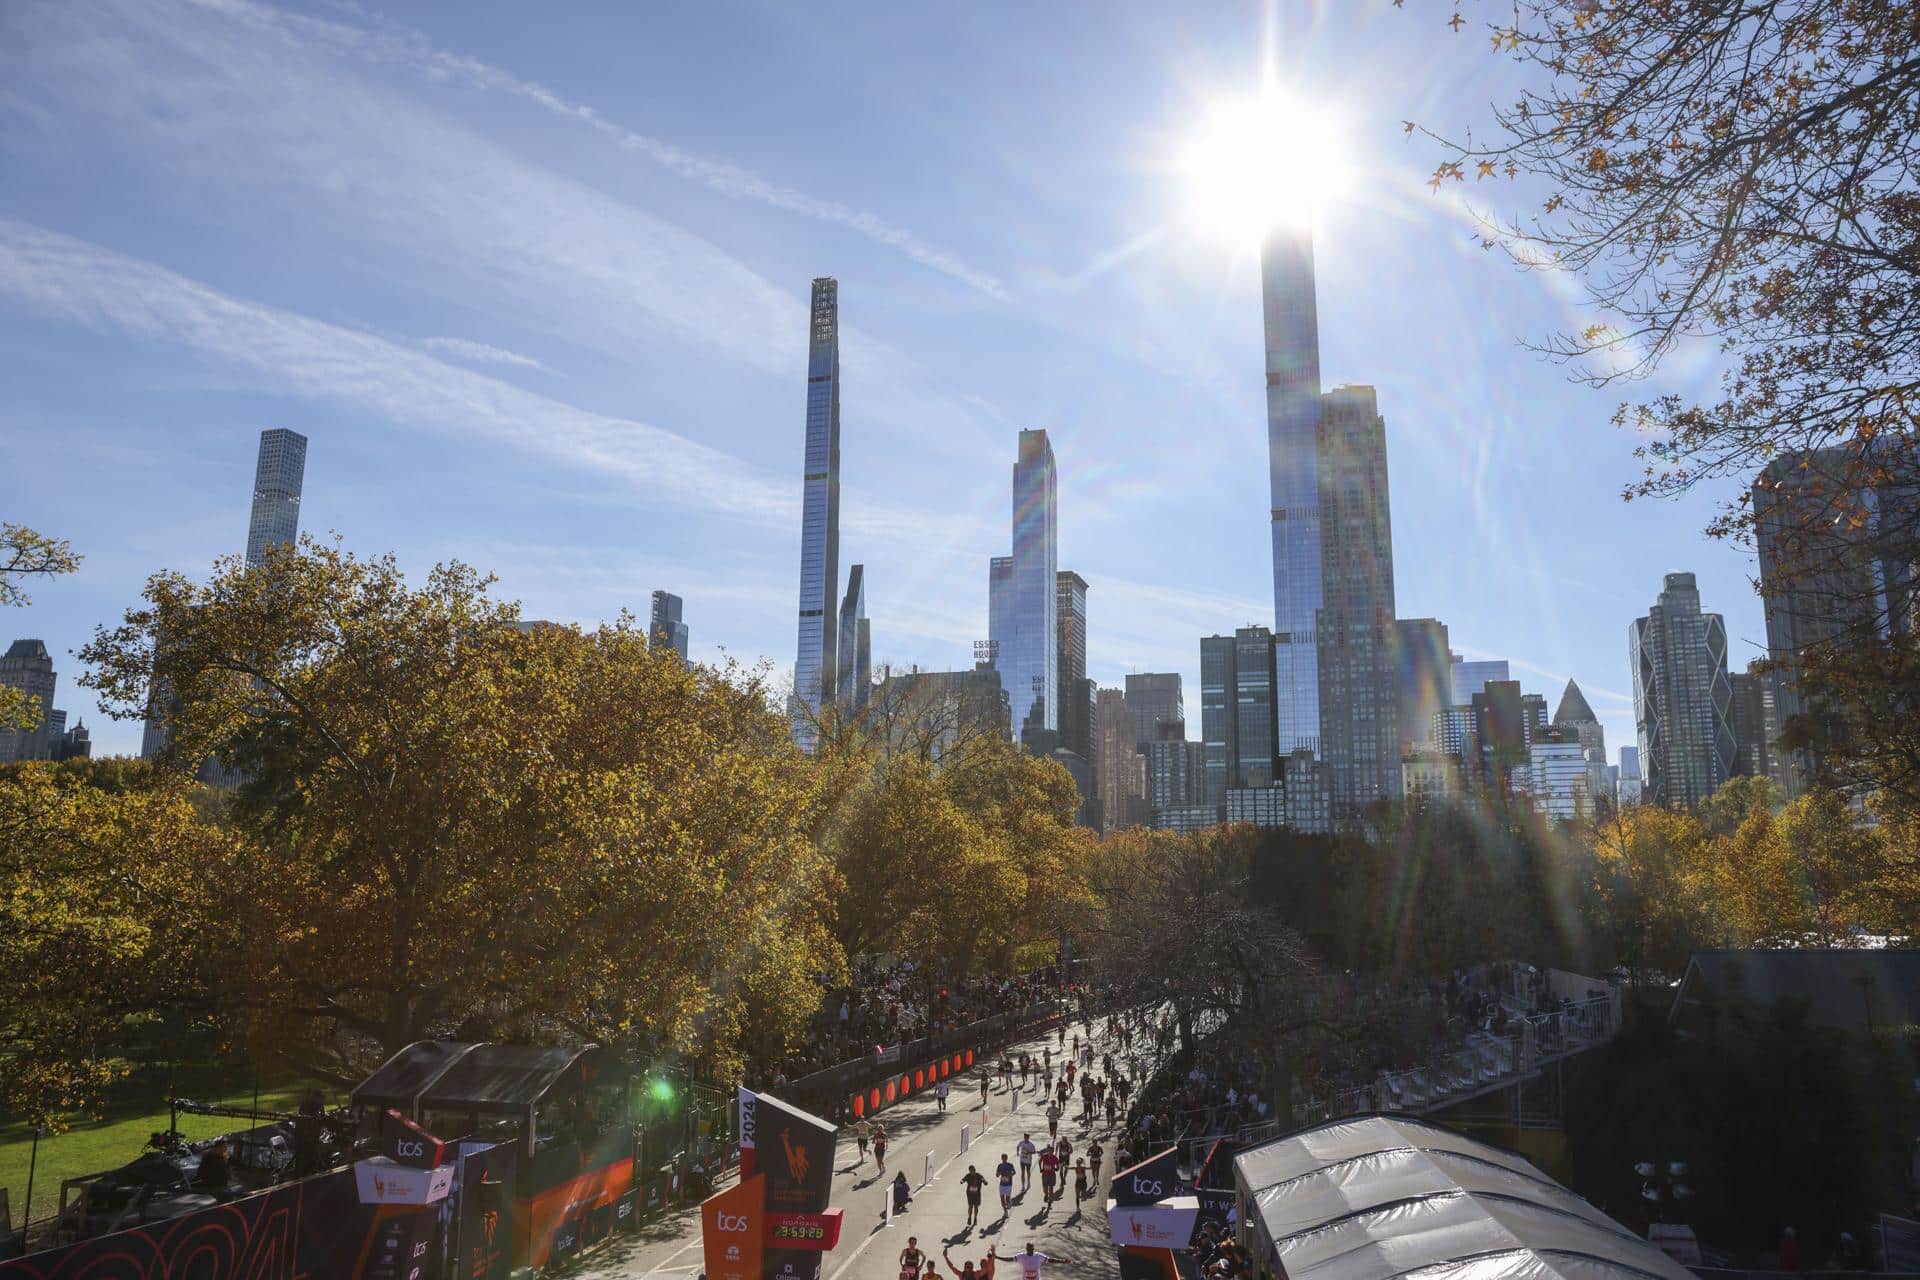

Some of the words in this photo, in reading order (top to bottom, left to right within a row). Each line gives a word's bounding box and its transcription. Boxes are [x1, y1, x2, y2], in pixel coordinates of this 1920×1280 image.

[973, 640, 1000, 649] ESSEX
[742, 1100, 756, 1143] 2024
[397, 1138, 424, 1157] tcs
[1133, 1175, 1162, 1195] tcs
[717, 1209, 749, 1232] tcs
